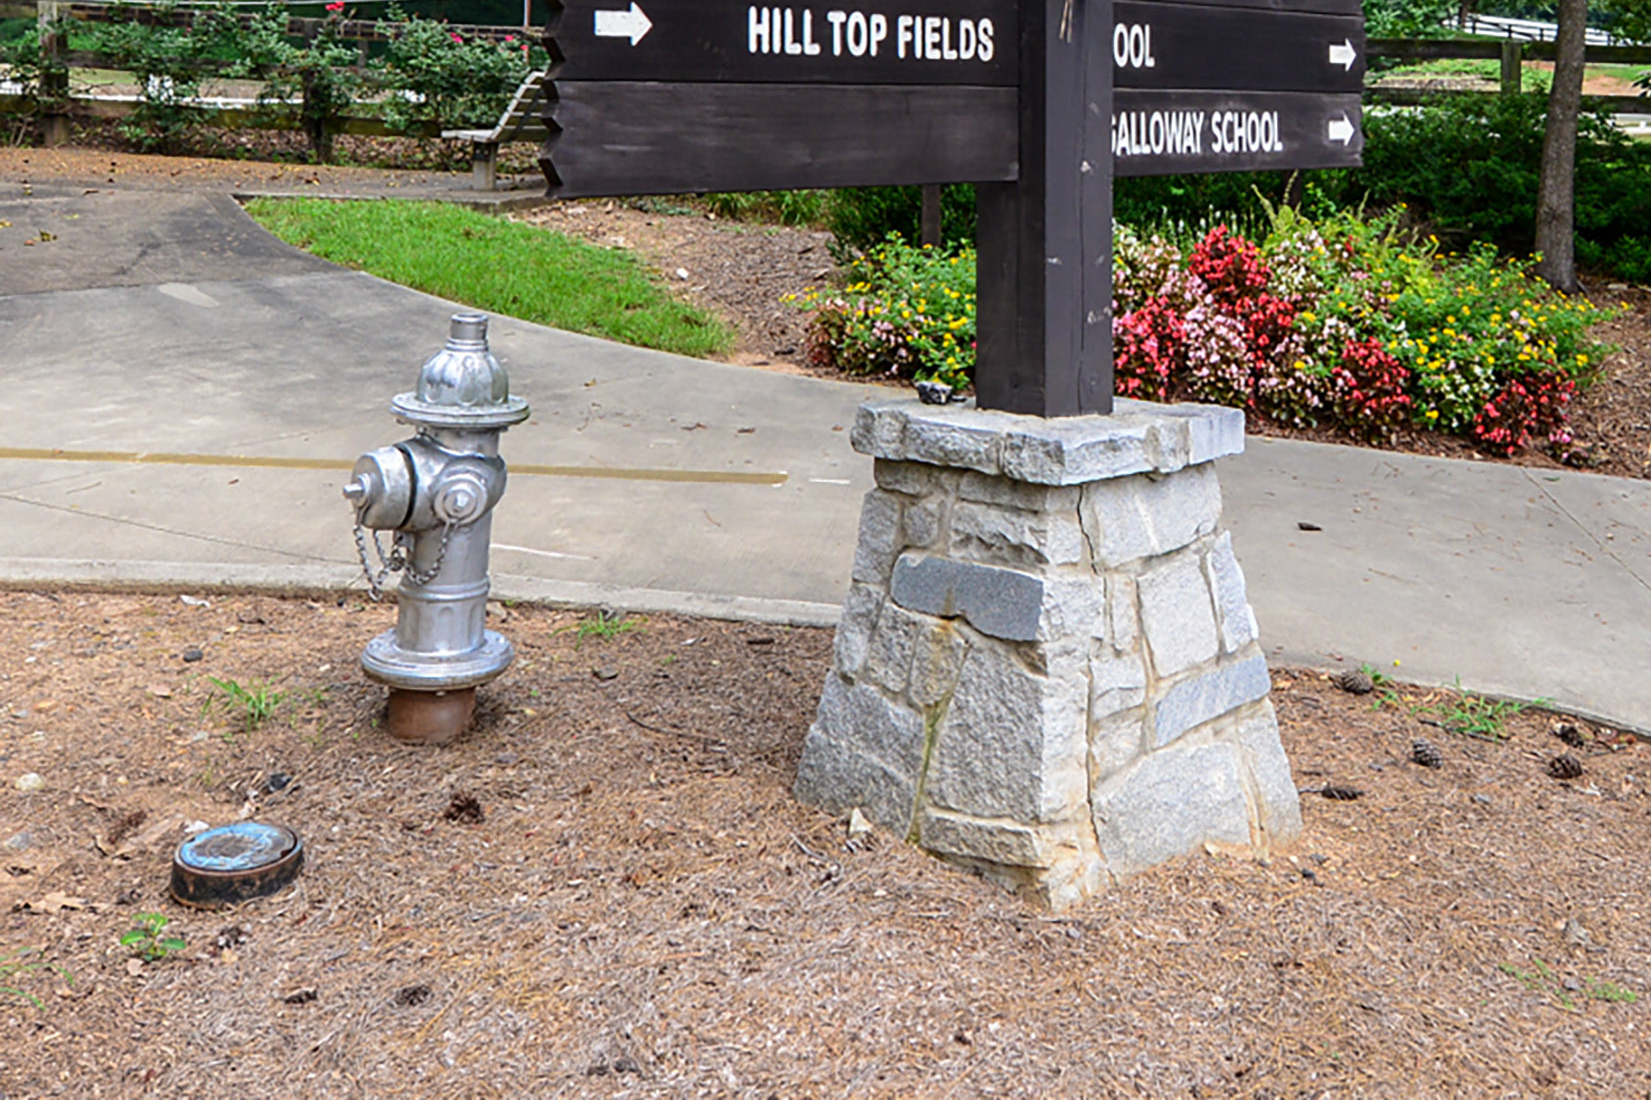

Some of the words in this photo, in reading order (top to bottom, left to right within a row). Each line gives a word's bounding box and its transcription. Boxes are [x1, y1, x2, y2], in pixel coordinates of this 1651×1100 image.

[748, 6, 820, 55] HILL
[827, 10, 887, 57] TOP
[897, 15, 994, 62] FIELDS
[1112, 22, 1155, 68] OOL
[1211, 111, 1283, 154] SCHOOL
